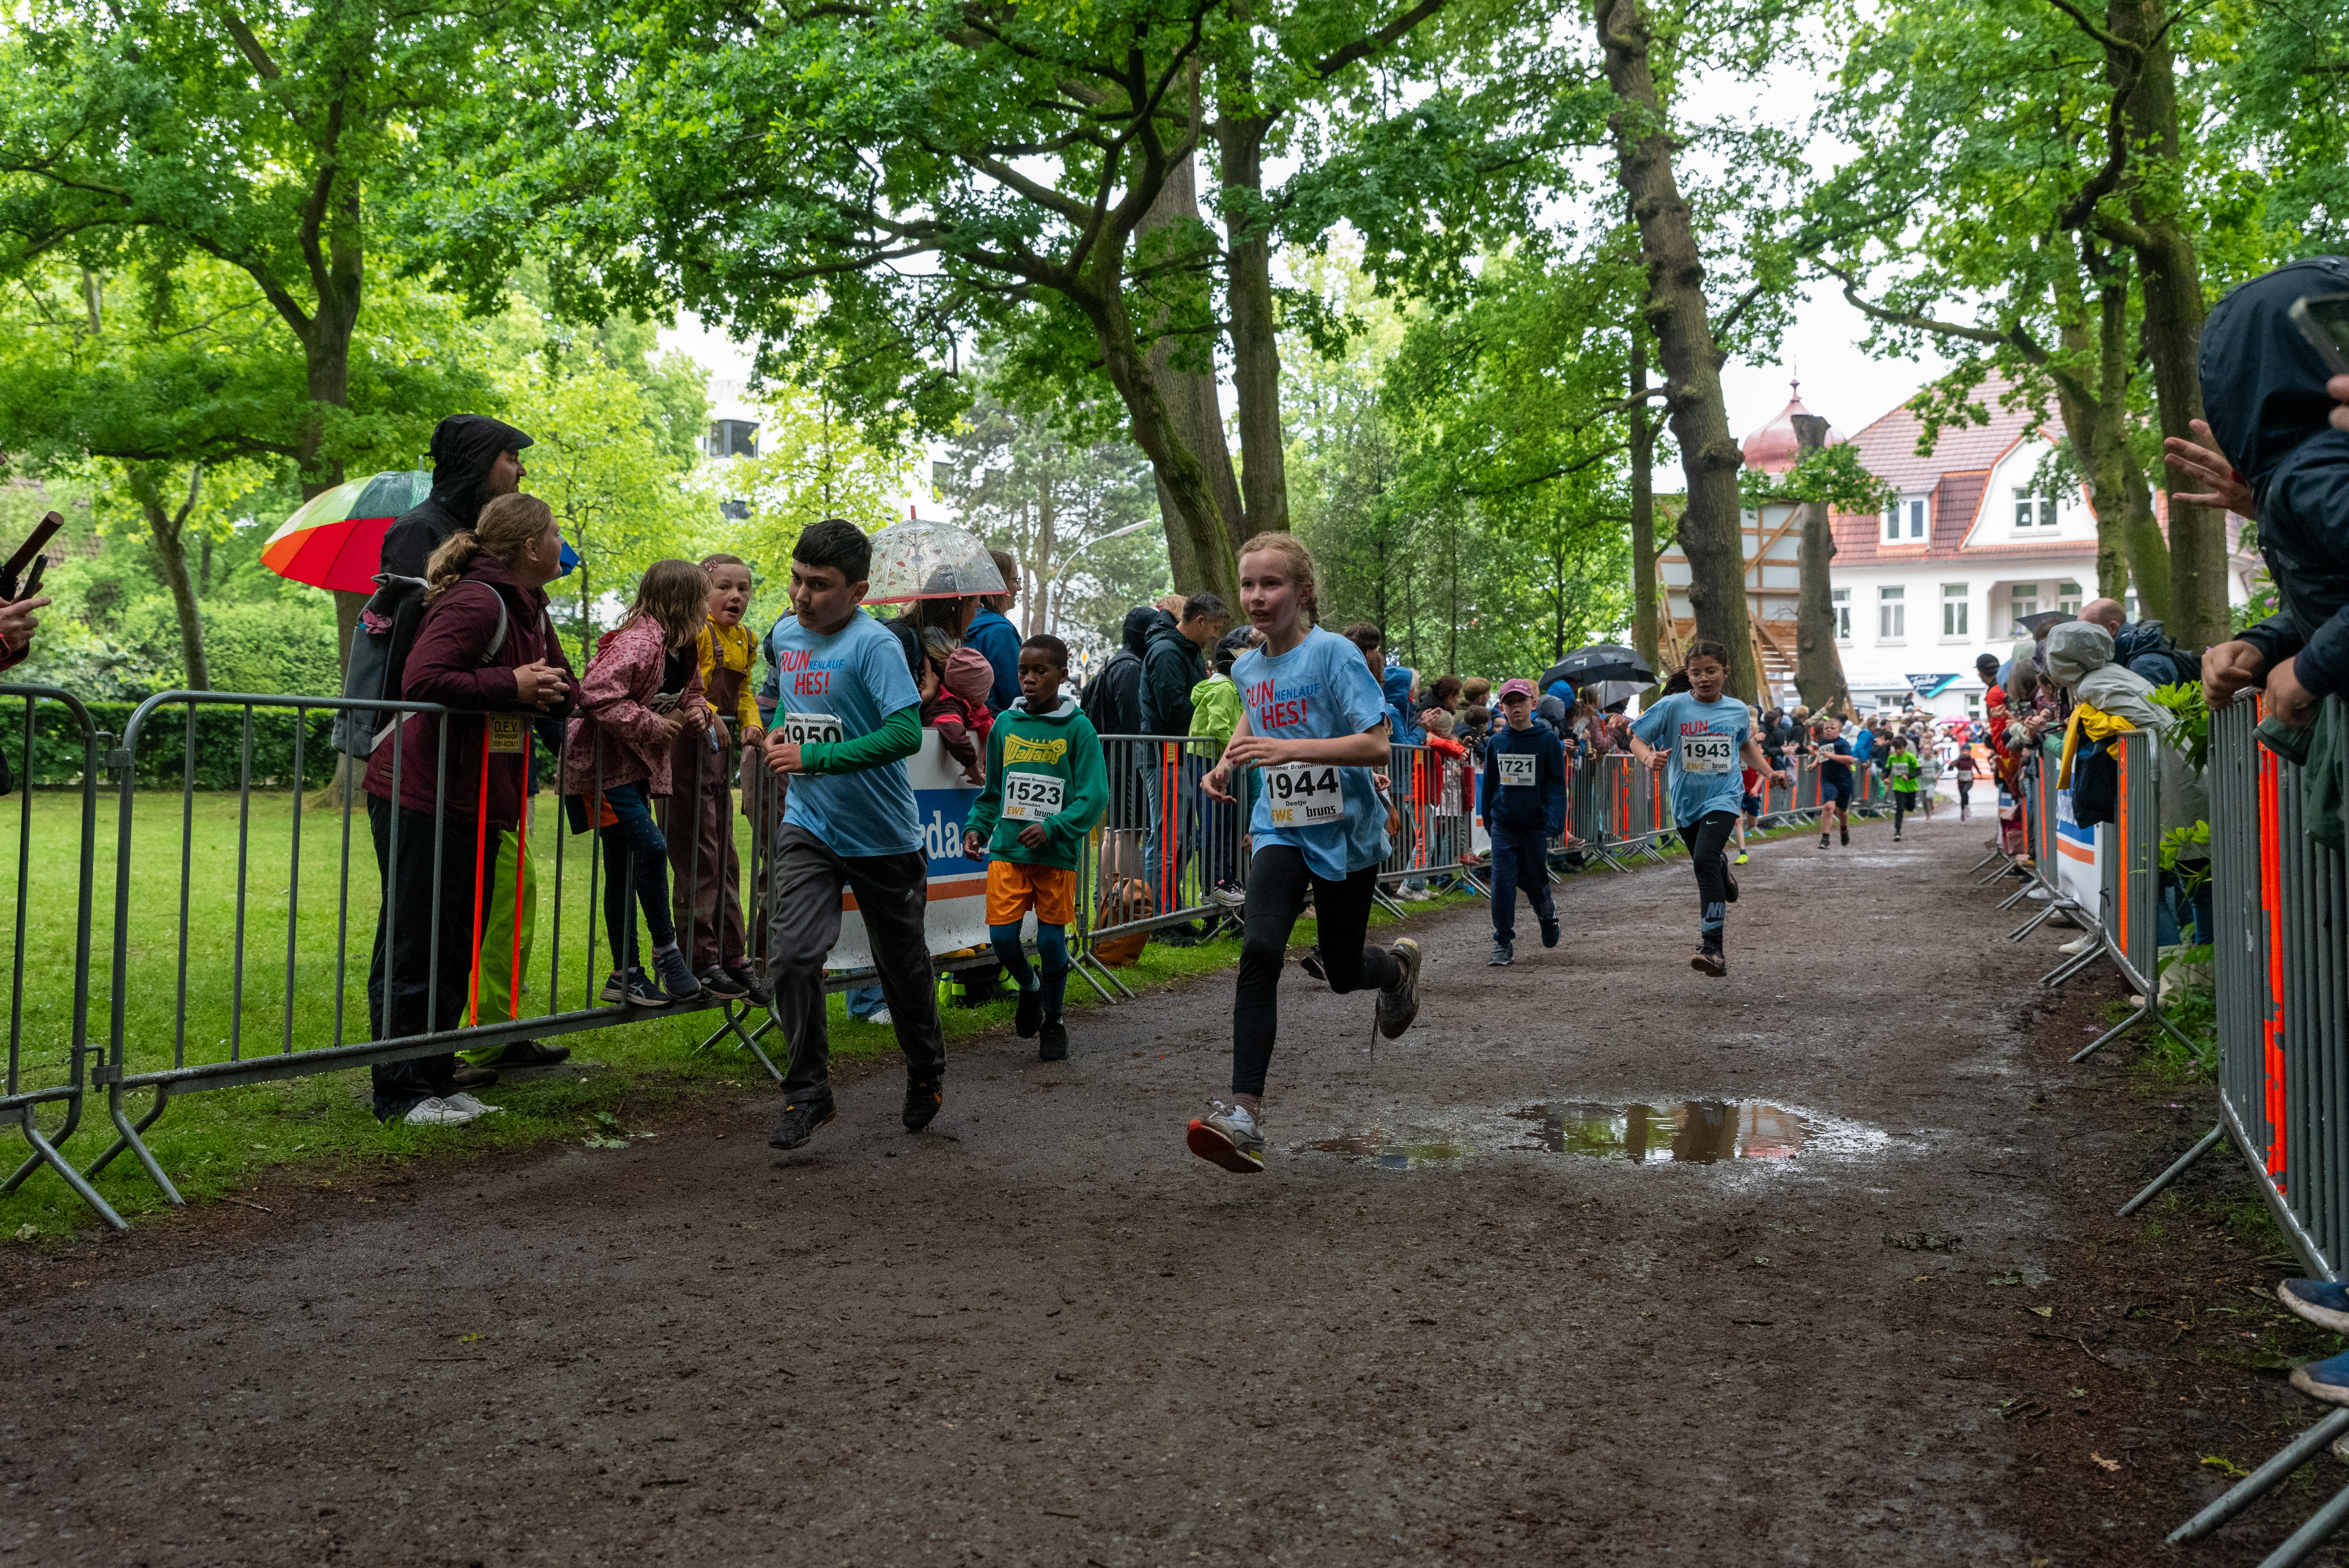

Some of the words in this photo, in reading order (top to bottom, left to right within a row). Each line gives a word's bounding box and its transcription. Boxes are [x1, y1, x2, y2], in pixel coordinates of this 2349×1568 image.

[794, 671, 830, 695] HES!
[1261, 699, 1307, 730] HES!
[494, 721, 518, 732] D.E.V.
[1684, 743, 1730, 758] 1943
[1499, 760, 1533, 773] 1721
[1267, 768, 1339, 799] 1944
[1007, 781, 1061, 805] 1523
[1006, 806, 1026, 816] EWE
[1272, 809, 1293, 822] EWE
[1306, 805, 1336, 817] bruns
